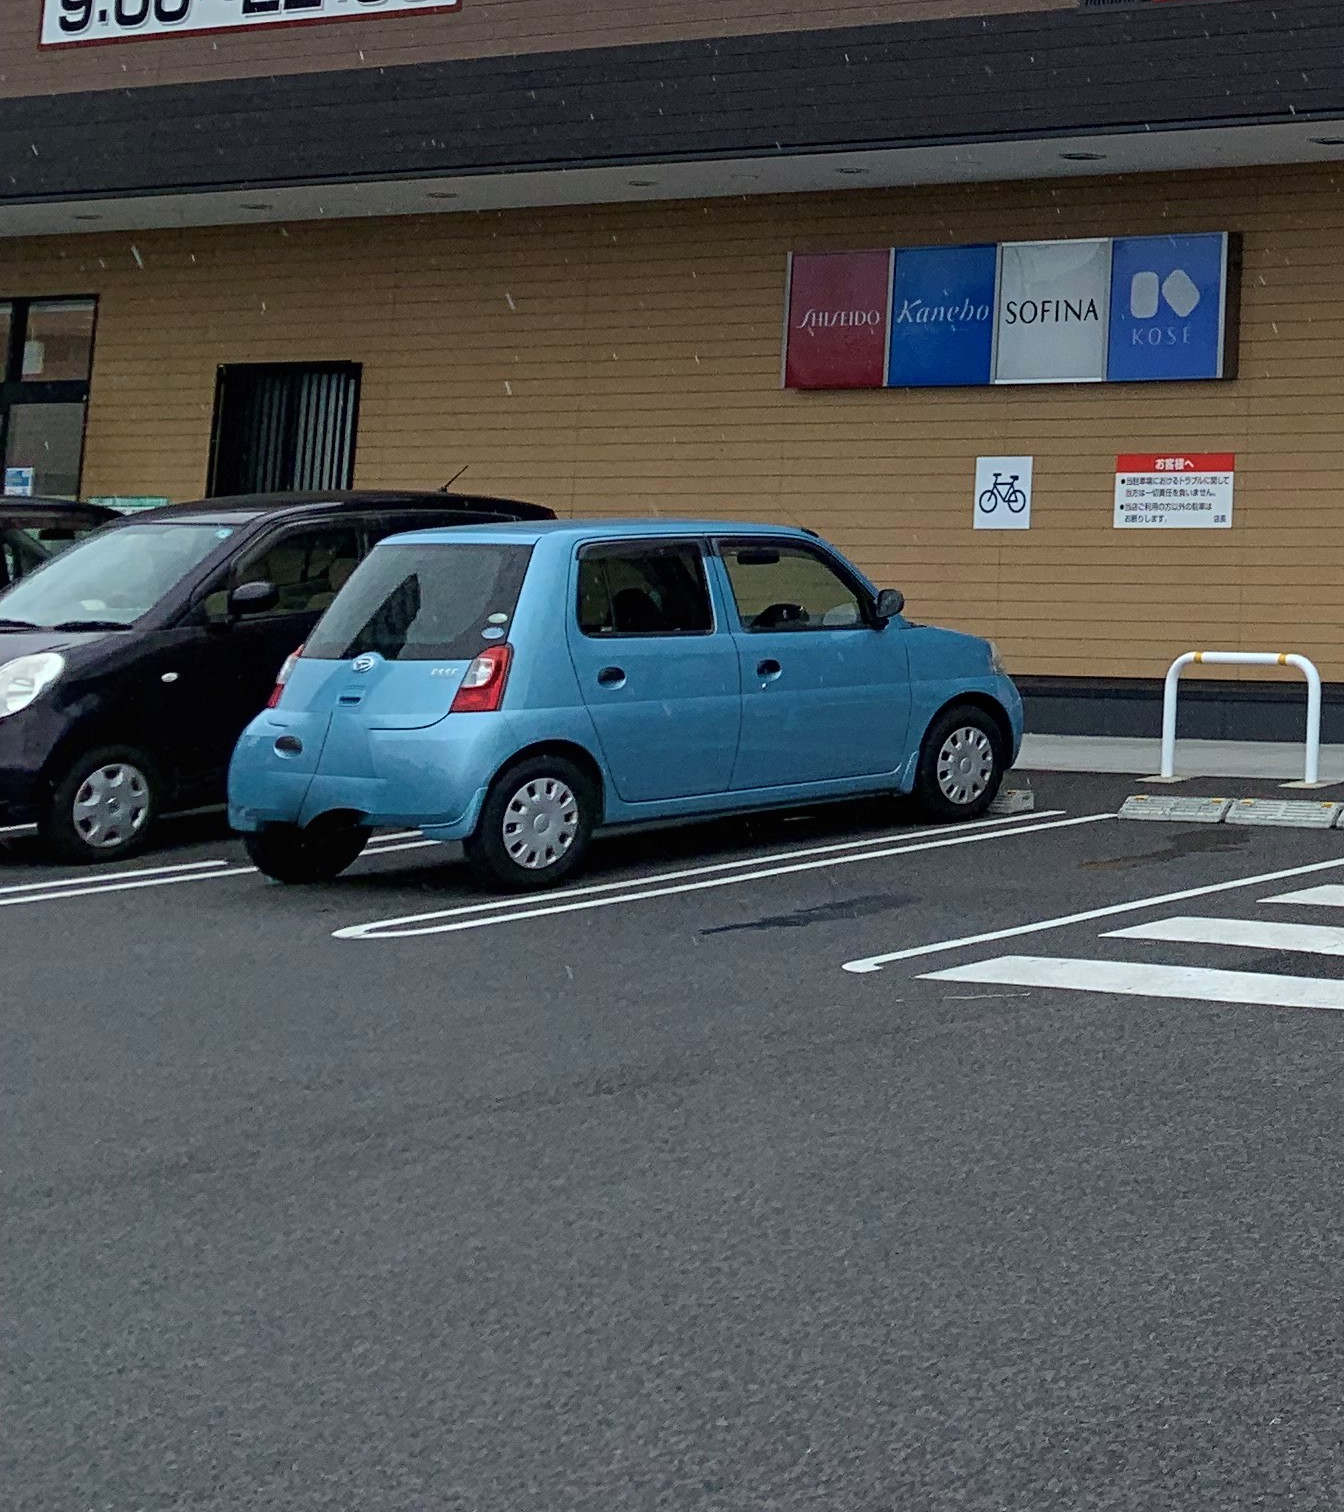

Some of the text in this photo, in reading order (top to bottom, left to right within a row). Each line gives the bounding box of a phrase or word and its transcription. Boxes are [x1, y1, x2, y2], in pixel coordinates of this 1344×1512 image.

[796, 307, 881, 330] SHISEIDO
[897, 298, 990, 325] Kanebo
[1005, 297, 1099, 325] SOFINA
[1154, 457, 1195, 471] お客様へ
